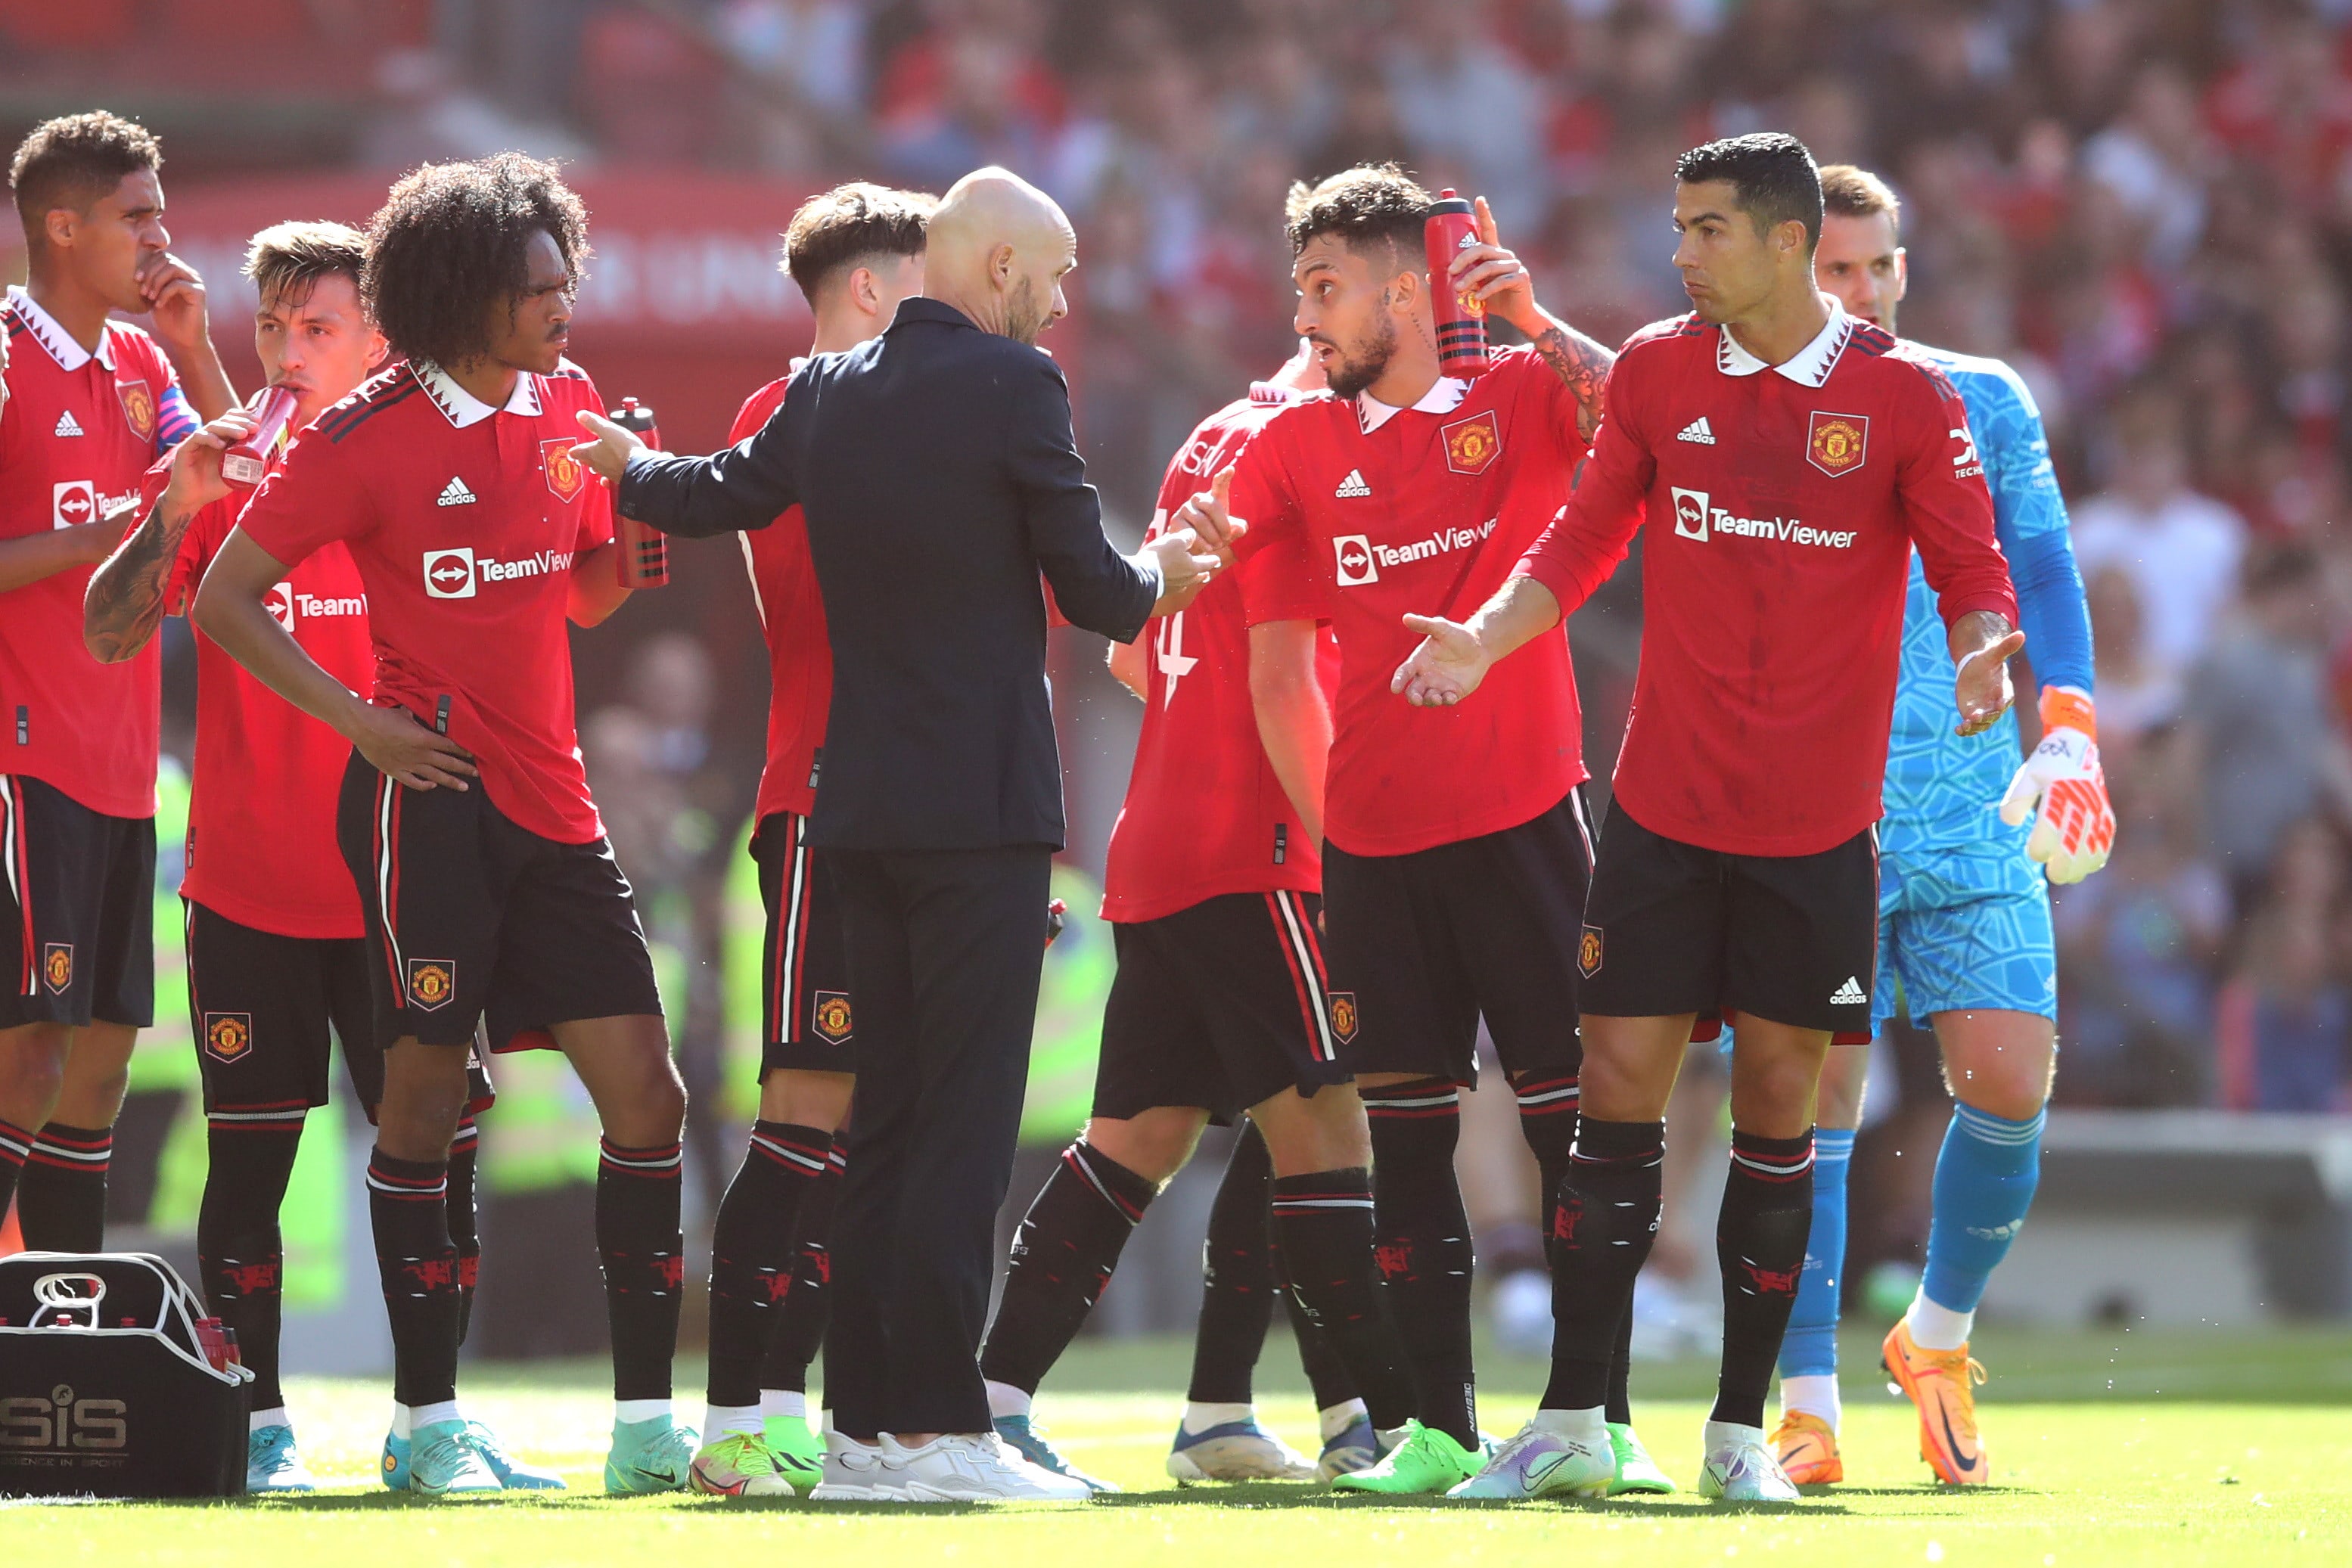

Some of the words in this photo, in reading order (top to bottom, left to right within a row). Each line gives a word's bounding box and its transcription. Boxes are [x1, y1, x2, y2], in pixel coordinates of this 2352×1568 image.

[54, 427, 84, 436] adidas
[1676, 431, 1716, 445] adidas
[1822, 454, 1850, 464] UNITED
[1335, 487, 1371, 498] adidas
[437, 493, 477, 506] adidas
[1710, 508, 1858, 548] TeamViewer
[1829, 994, 1867, 1004] adidas
[1464, 1383, 1475, 1433] DESIGN
